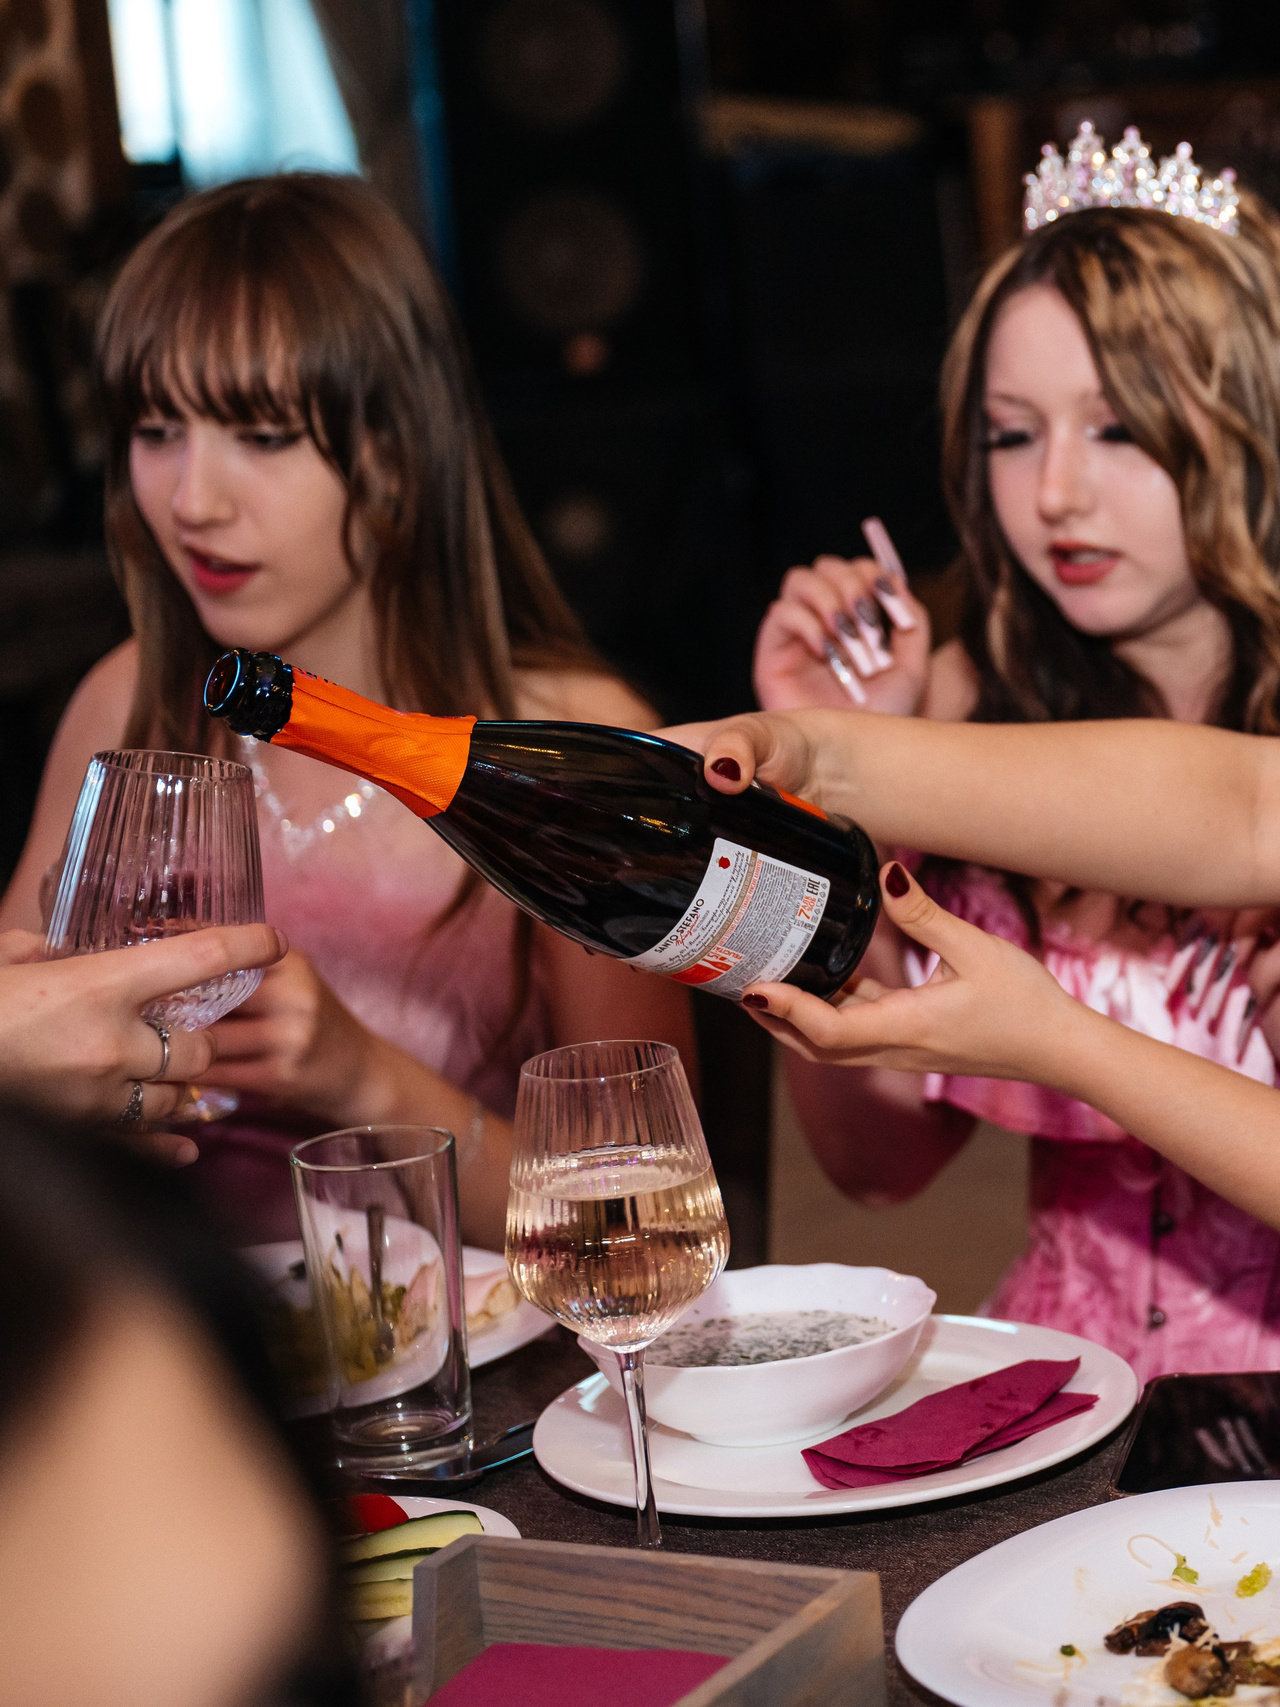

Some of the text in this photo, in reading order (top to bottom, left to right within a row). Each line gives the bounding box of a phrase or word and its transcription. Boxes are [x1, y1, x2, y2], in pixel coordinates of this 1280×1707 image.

[653, 933, 678, 953] SANTO
[676, 897, 705, 935] STEFANO
[797, 907, 810, 920] 7
